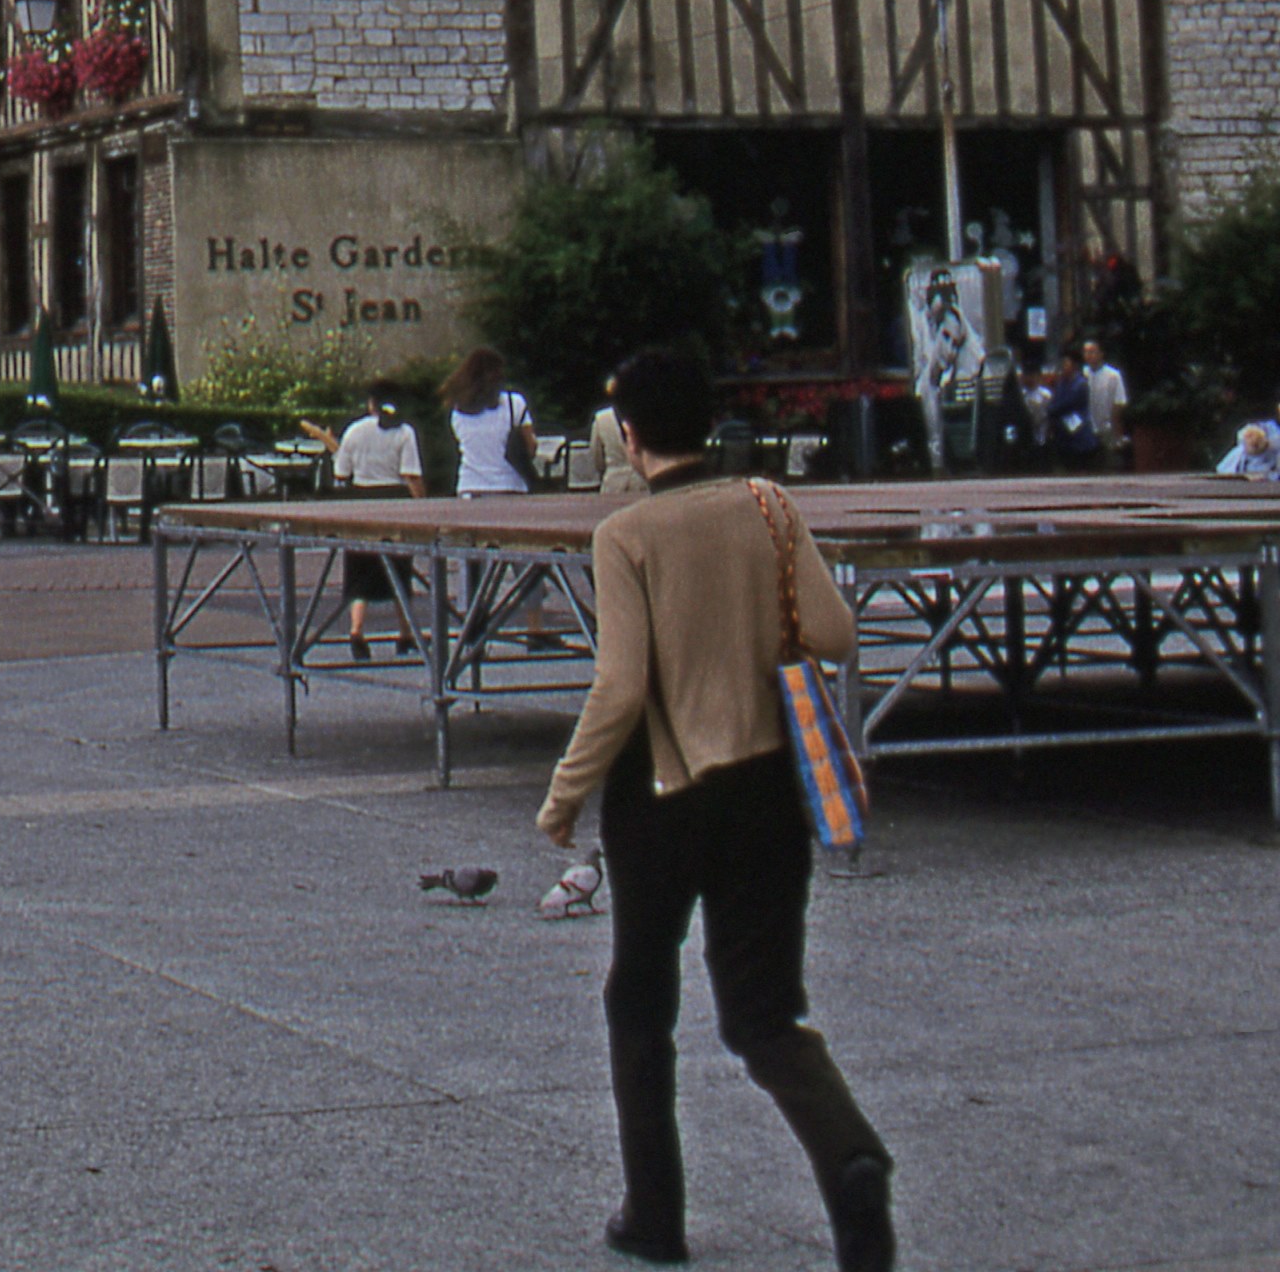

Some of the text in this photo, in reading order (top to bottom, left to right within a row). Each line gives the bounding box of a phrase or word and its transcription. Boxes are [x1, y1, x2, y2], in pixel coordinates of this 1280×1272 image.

[207, 236, 311, 270] Halte
[290, 286, 422, 328] St Jean
